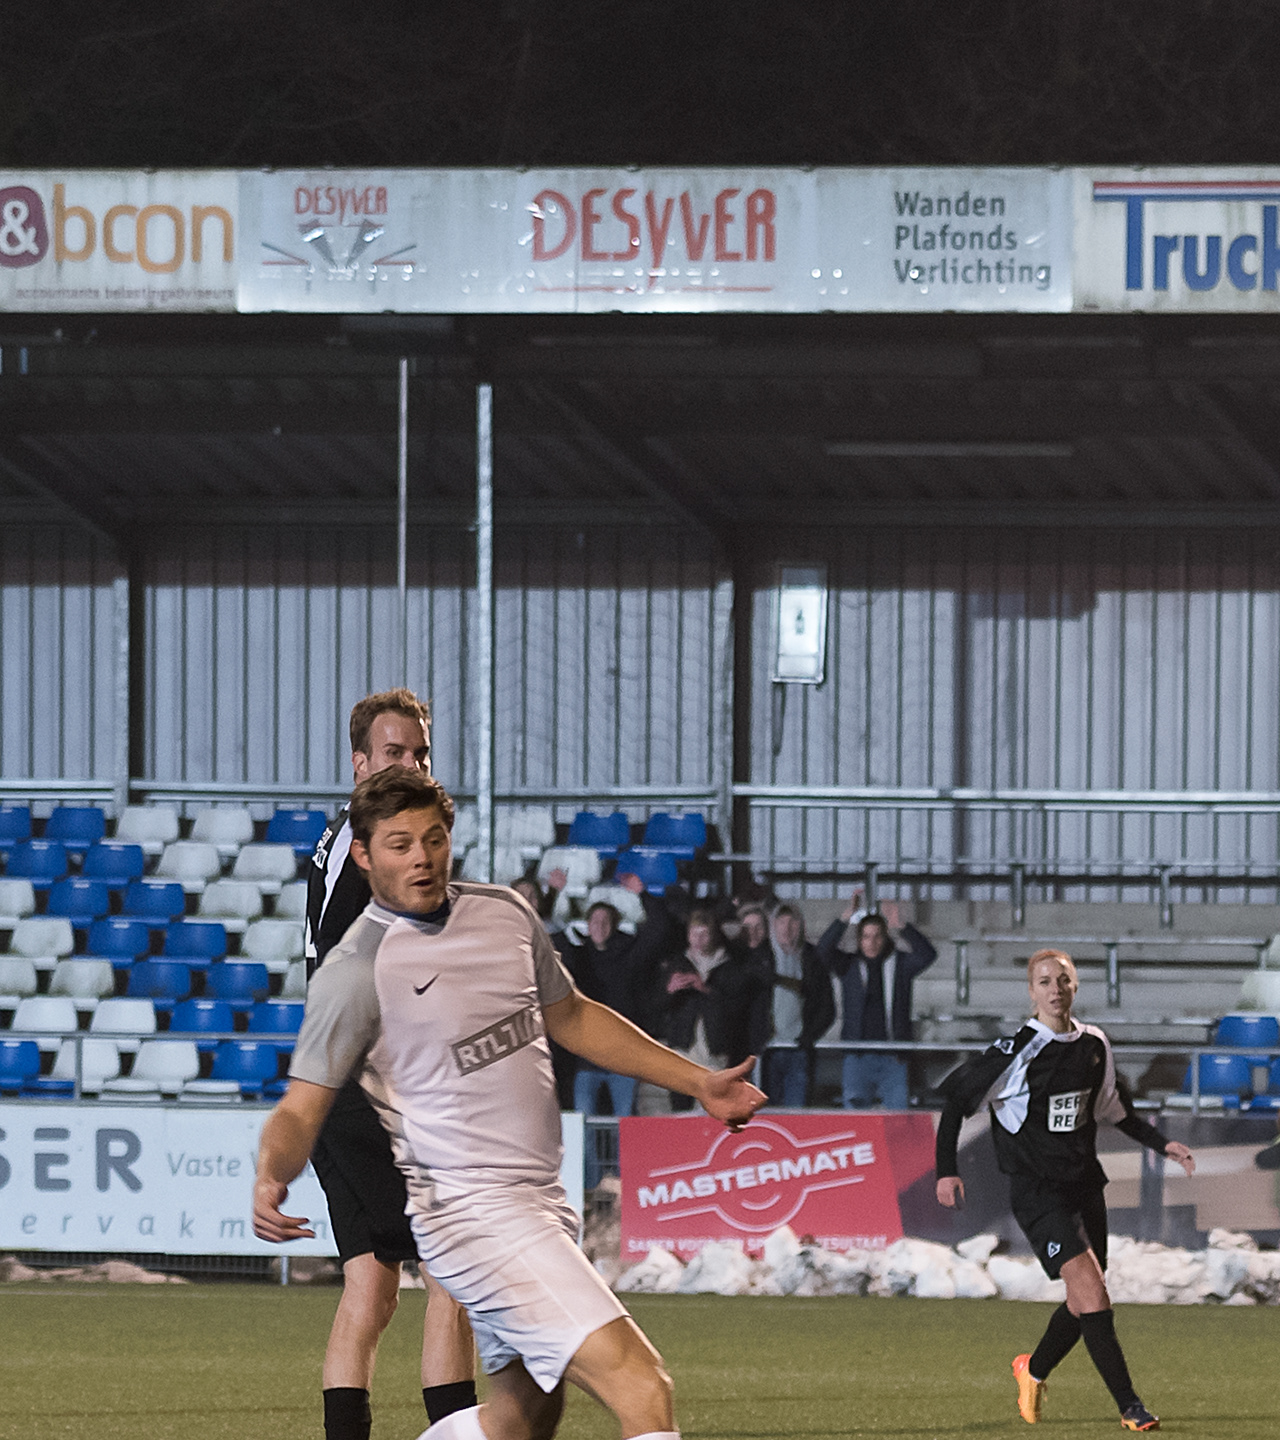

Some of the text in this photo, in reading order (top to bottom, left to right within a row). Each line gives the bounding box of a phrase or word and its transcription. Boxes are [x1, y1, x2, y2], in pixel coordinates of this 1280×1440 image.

[894, 191, 1006, 217] Wanden
[532, 187, 776, 287] DESYVER
[894, 224, 1018, 252] Plafonds
[894, 258, 1051, 290] Verlichting
[167, 1152, 241, 1178] Vaste
[637, 1141, 876, 1208] MASTERMATE
